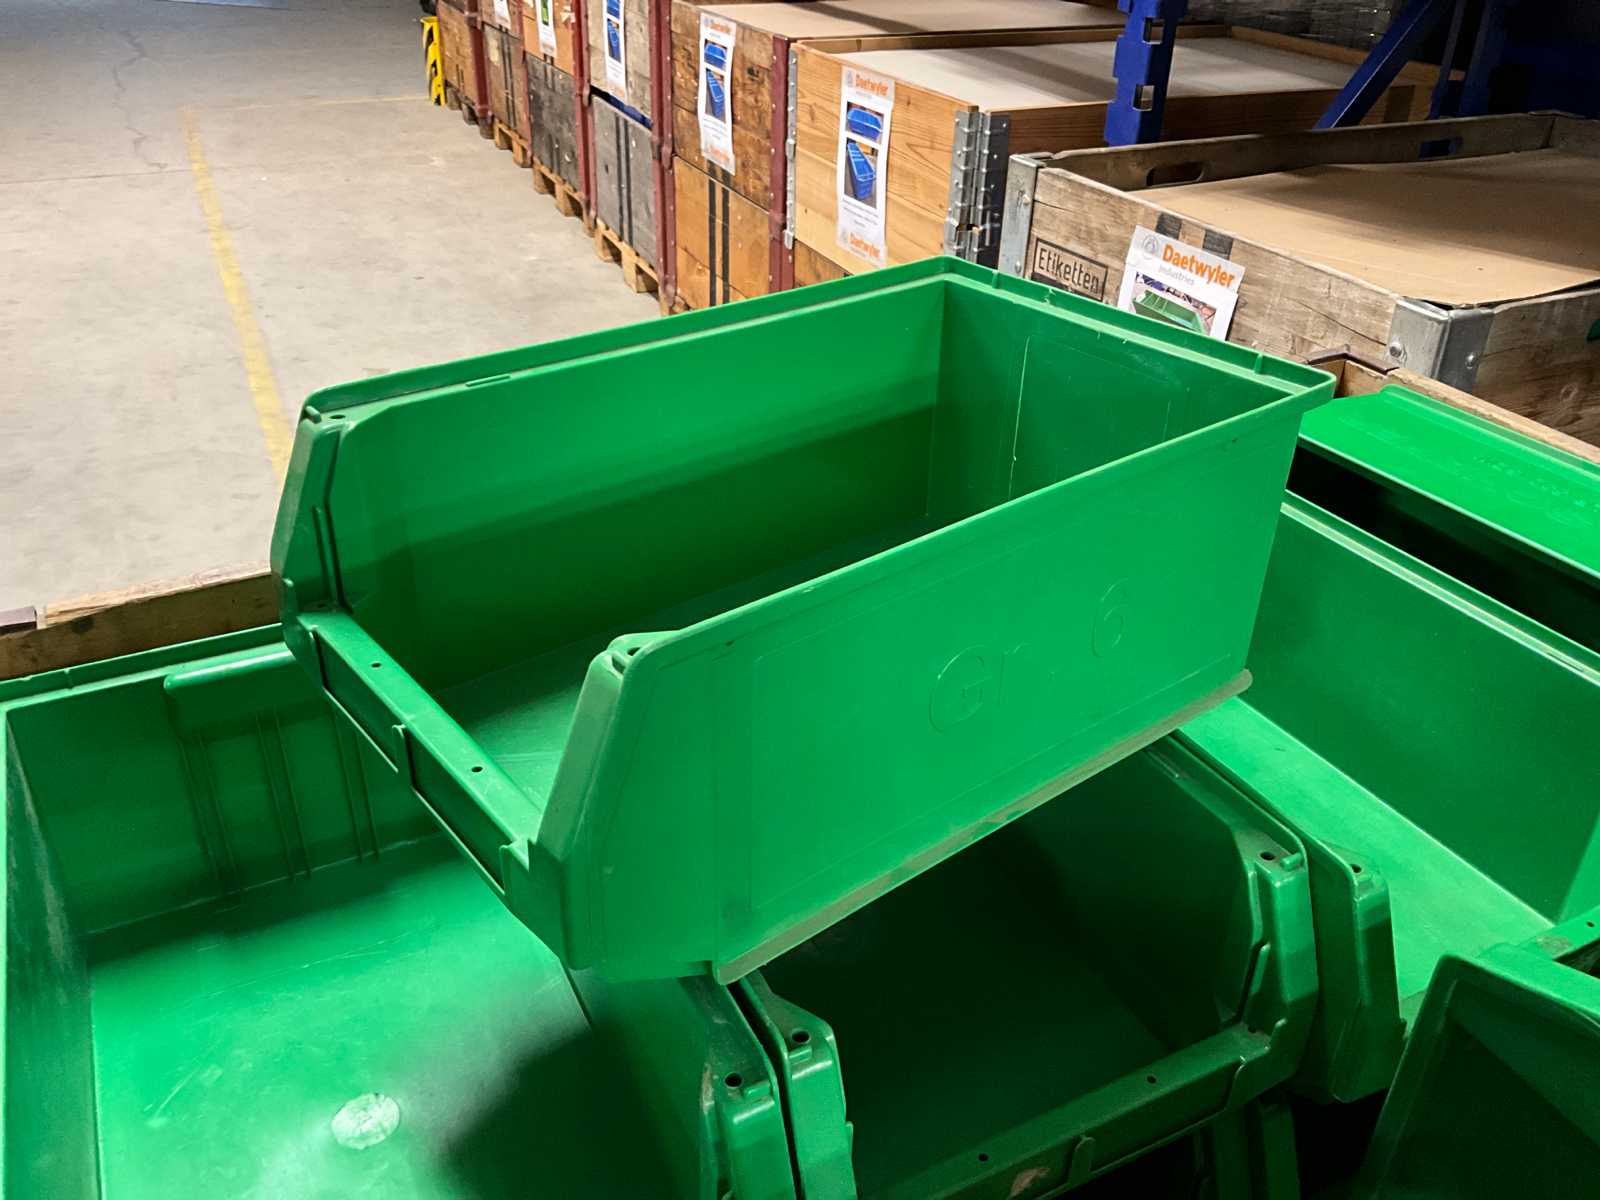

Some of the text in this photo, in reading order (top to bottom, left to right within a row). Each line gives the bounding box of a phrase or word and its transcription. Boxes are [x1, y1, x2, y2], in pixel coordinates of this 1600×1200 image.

[1038, 247, 1100, 294] Etiketten
[1162, 243, 1236, 288] Daetwyler
[1088, 576, 1128, 660] 6
